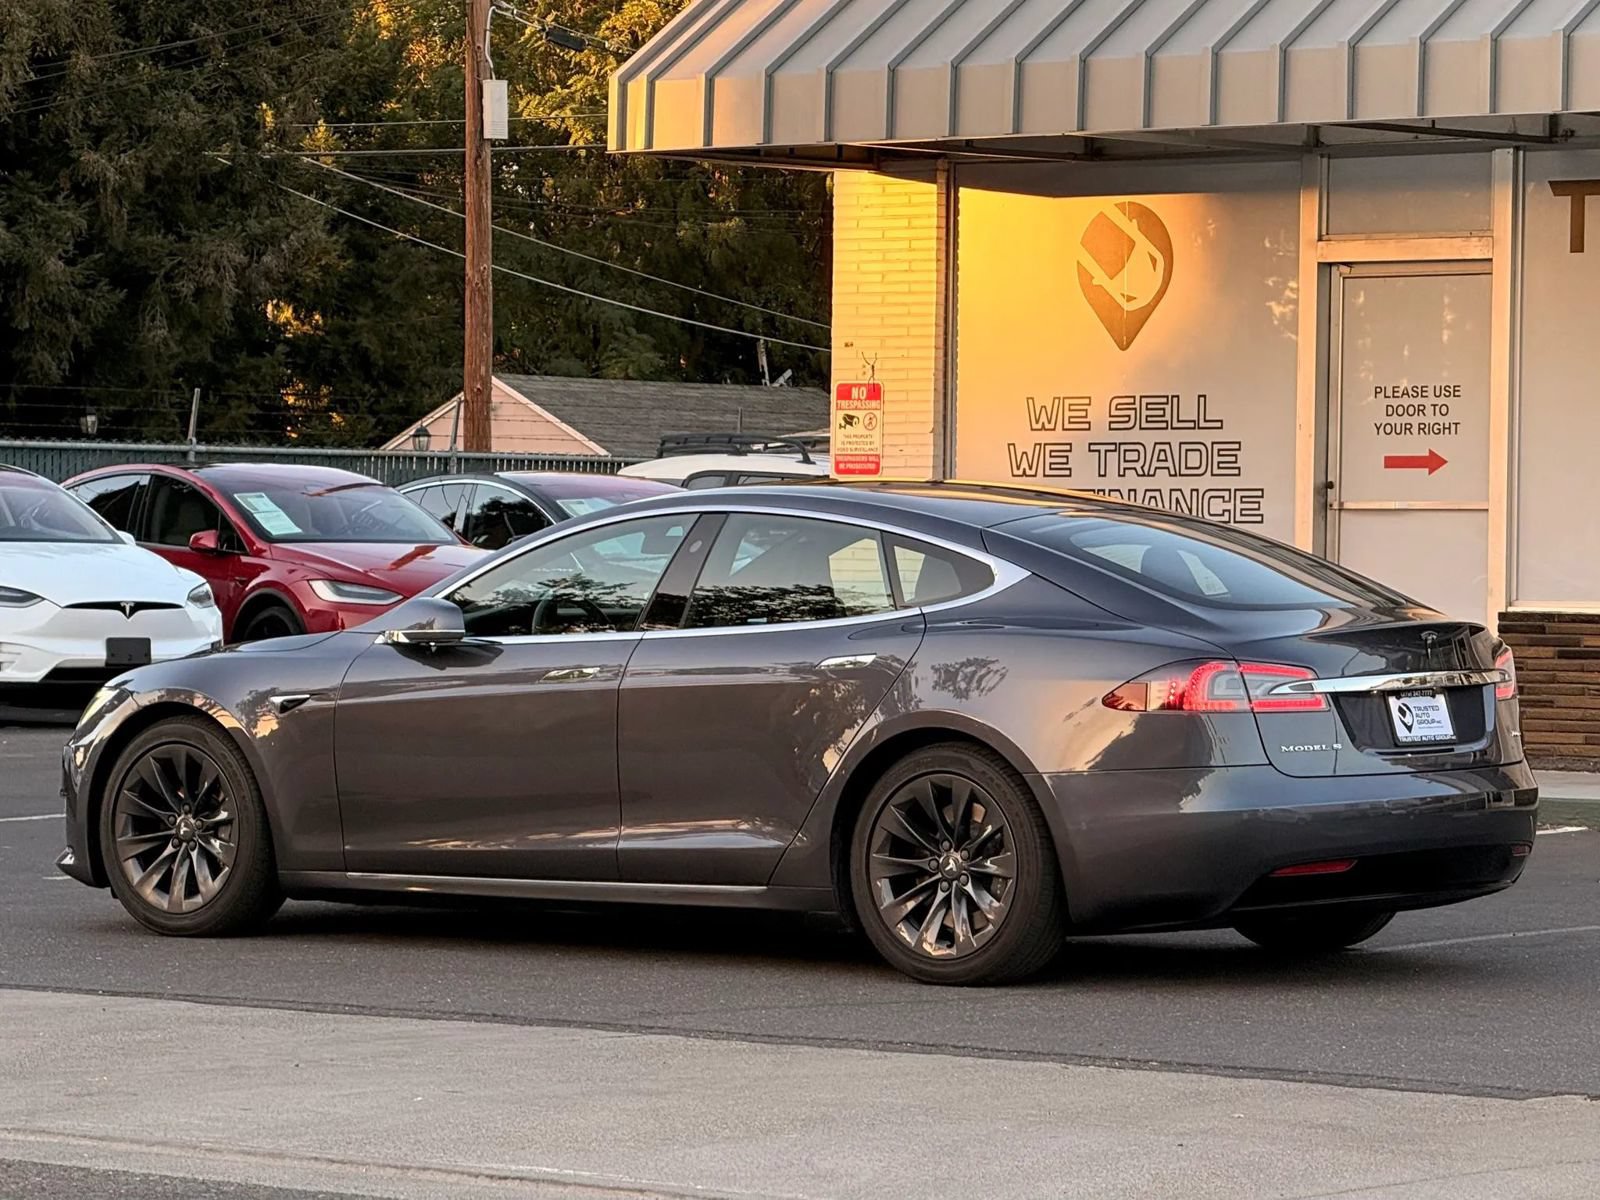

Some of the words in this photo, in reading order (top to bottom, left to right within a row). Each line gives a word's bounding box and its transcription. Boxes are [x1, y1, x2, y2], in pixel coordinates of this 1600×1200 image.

[851, 386, 867, 400] NO
[1374, 385, 1429, 399] PLEASE
[1433, 385, 1462, 398] USE
[1026, 396, 1092, 431] WE
[1108, 394, 1223, 431] SELL
[1385, 403, 1427, 417] DOOR
[1431, 403, 1449, 417] TO
[1374, 422, 1414, 436] YOUR
[1417, 422, 1461, 435] RIGHT
[1008, 442, 1072, 477] WE
[1088, 441, 1242, 477] TRADE
[1068, 488, 1264, 524] ANCE
[1280, 744, 1330, 752] MODEL
[1333, 743, 1343, 751] S
